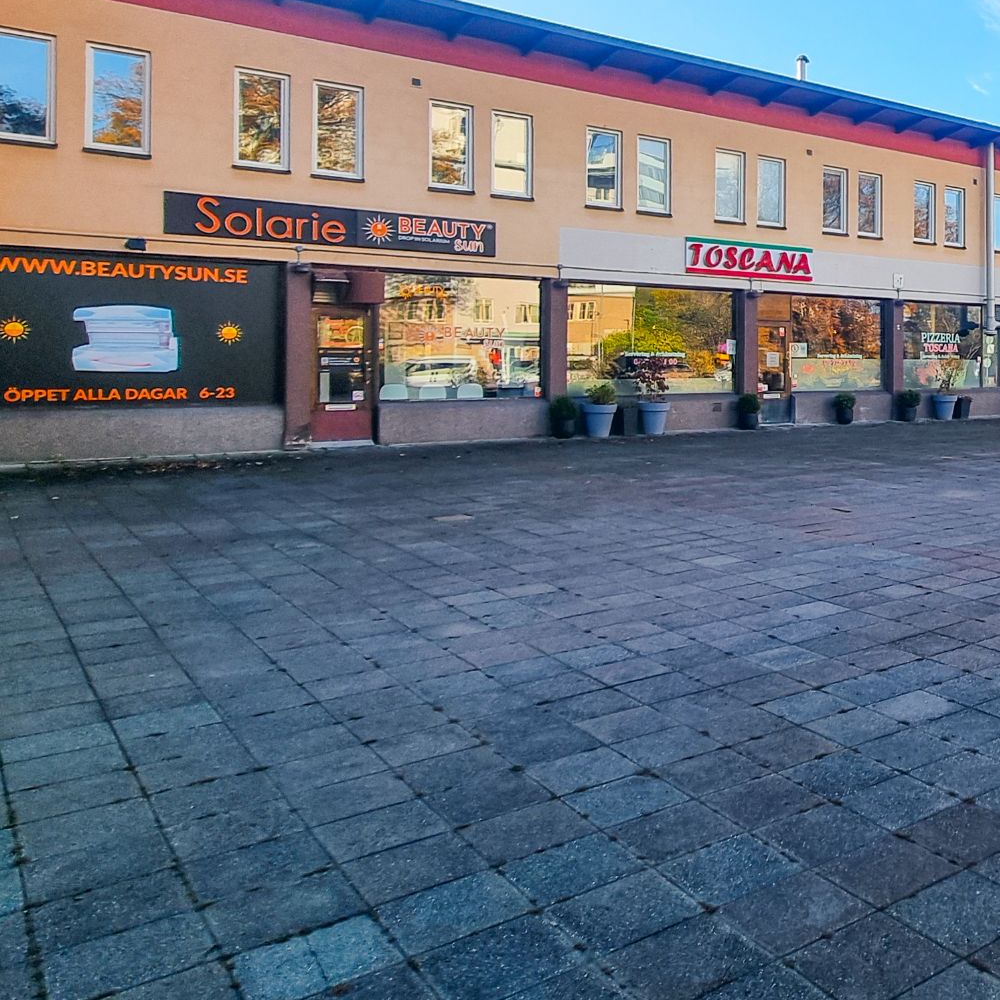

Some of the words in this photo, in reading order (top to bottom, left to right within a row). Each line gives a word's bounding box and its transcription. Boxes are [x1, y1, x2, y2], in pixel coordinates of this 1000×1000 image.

[194, 196, 347, 243] Solarie
[398, 216, 487, 240] BEAUTY
[454, 238, 484, 253] sun
[688, 243, 811, 275] TOSCANA
[0, 256, 249, 284] WWW.BEAUTYSUN.SE
[444, 326, 506, 338] BEAUTY
[921, 332, 961, 344] PIZZERIA
[923, 343, 958, 353] TOSCANA
[4, 387, 70, 402] ÖPPET
[72, 388, 121, 401] ALLA
[125, 388, 188, 400] DAGAR
[199, 387, 236, 399] 6-23
